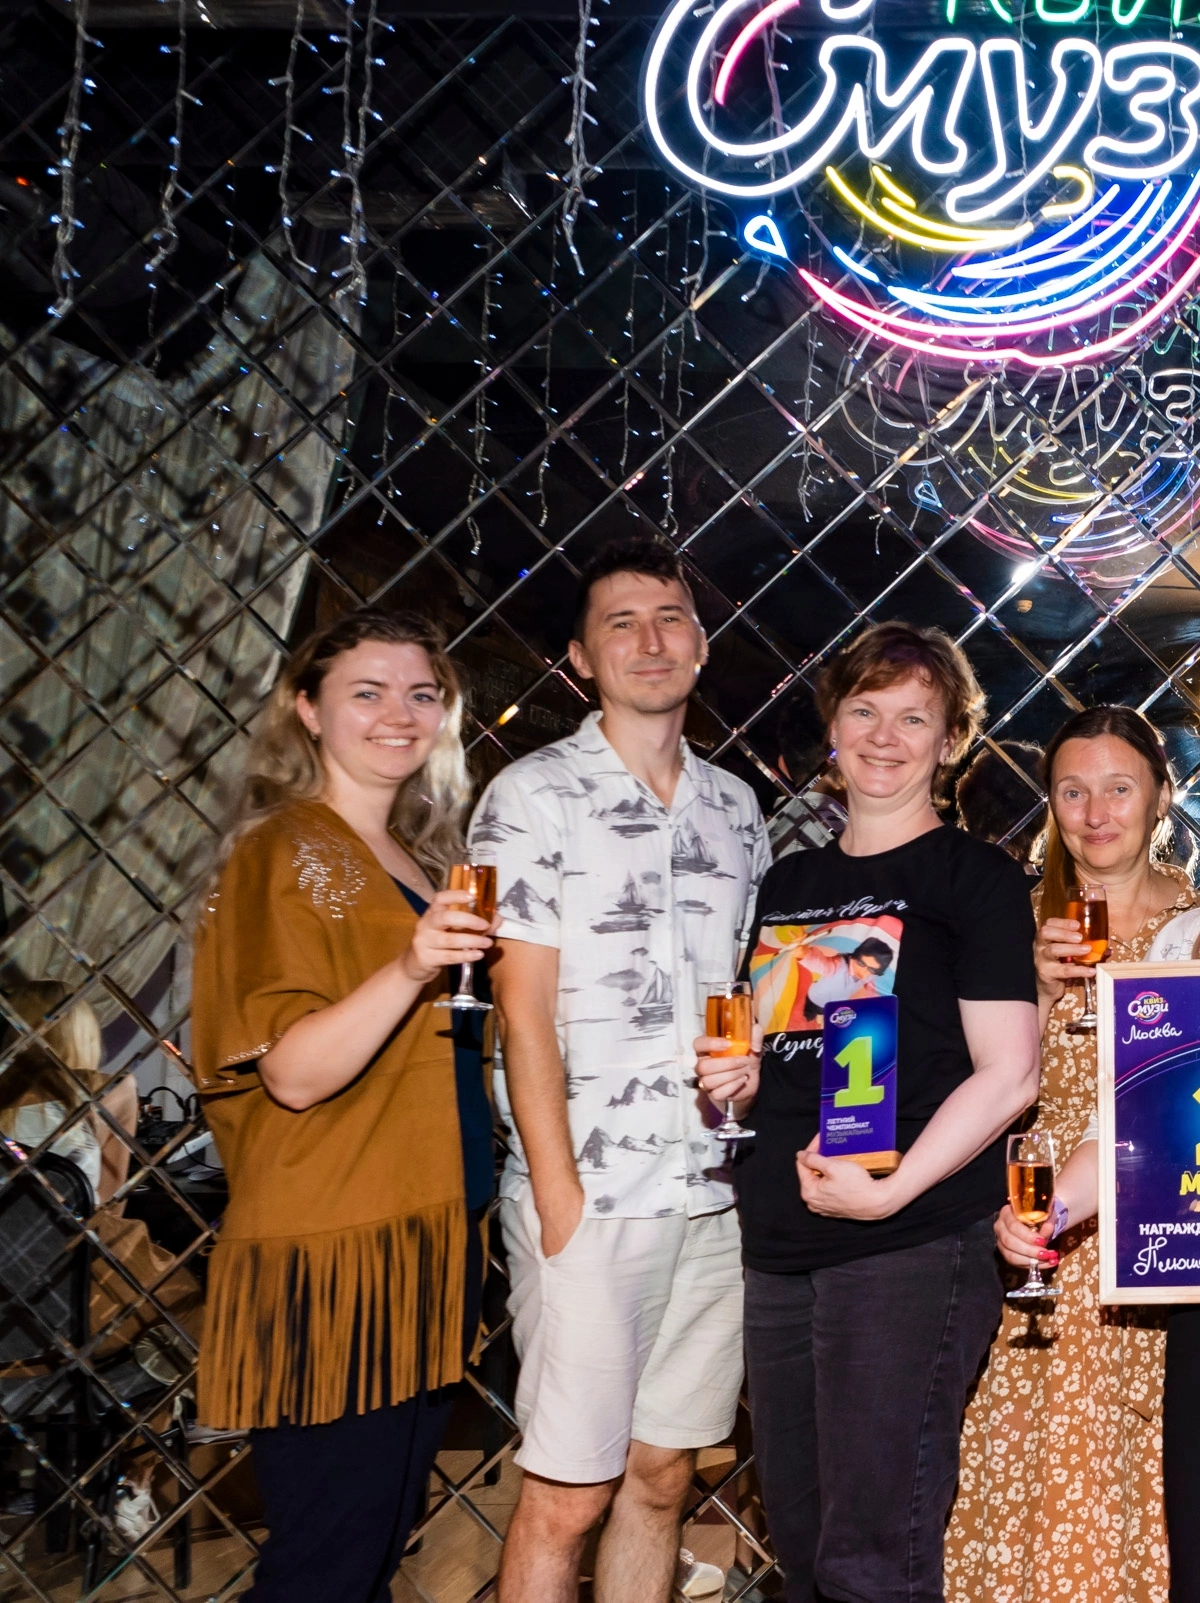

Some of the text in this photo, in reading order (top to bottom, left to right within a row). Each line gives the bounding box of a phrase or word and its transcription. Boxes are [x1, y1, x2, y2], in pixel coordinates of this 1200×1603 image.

[1127, 1000, 1169, 1017] Смузи
[1143, 997, 1164, 1005] КВИЗ
[1121, 1022, 1183, 1045] Москва
[833, 1036, 885, 1108] 1
[826, 1121, 870, 1131] ЧЕМПИОНАТ
